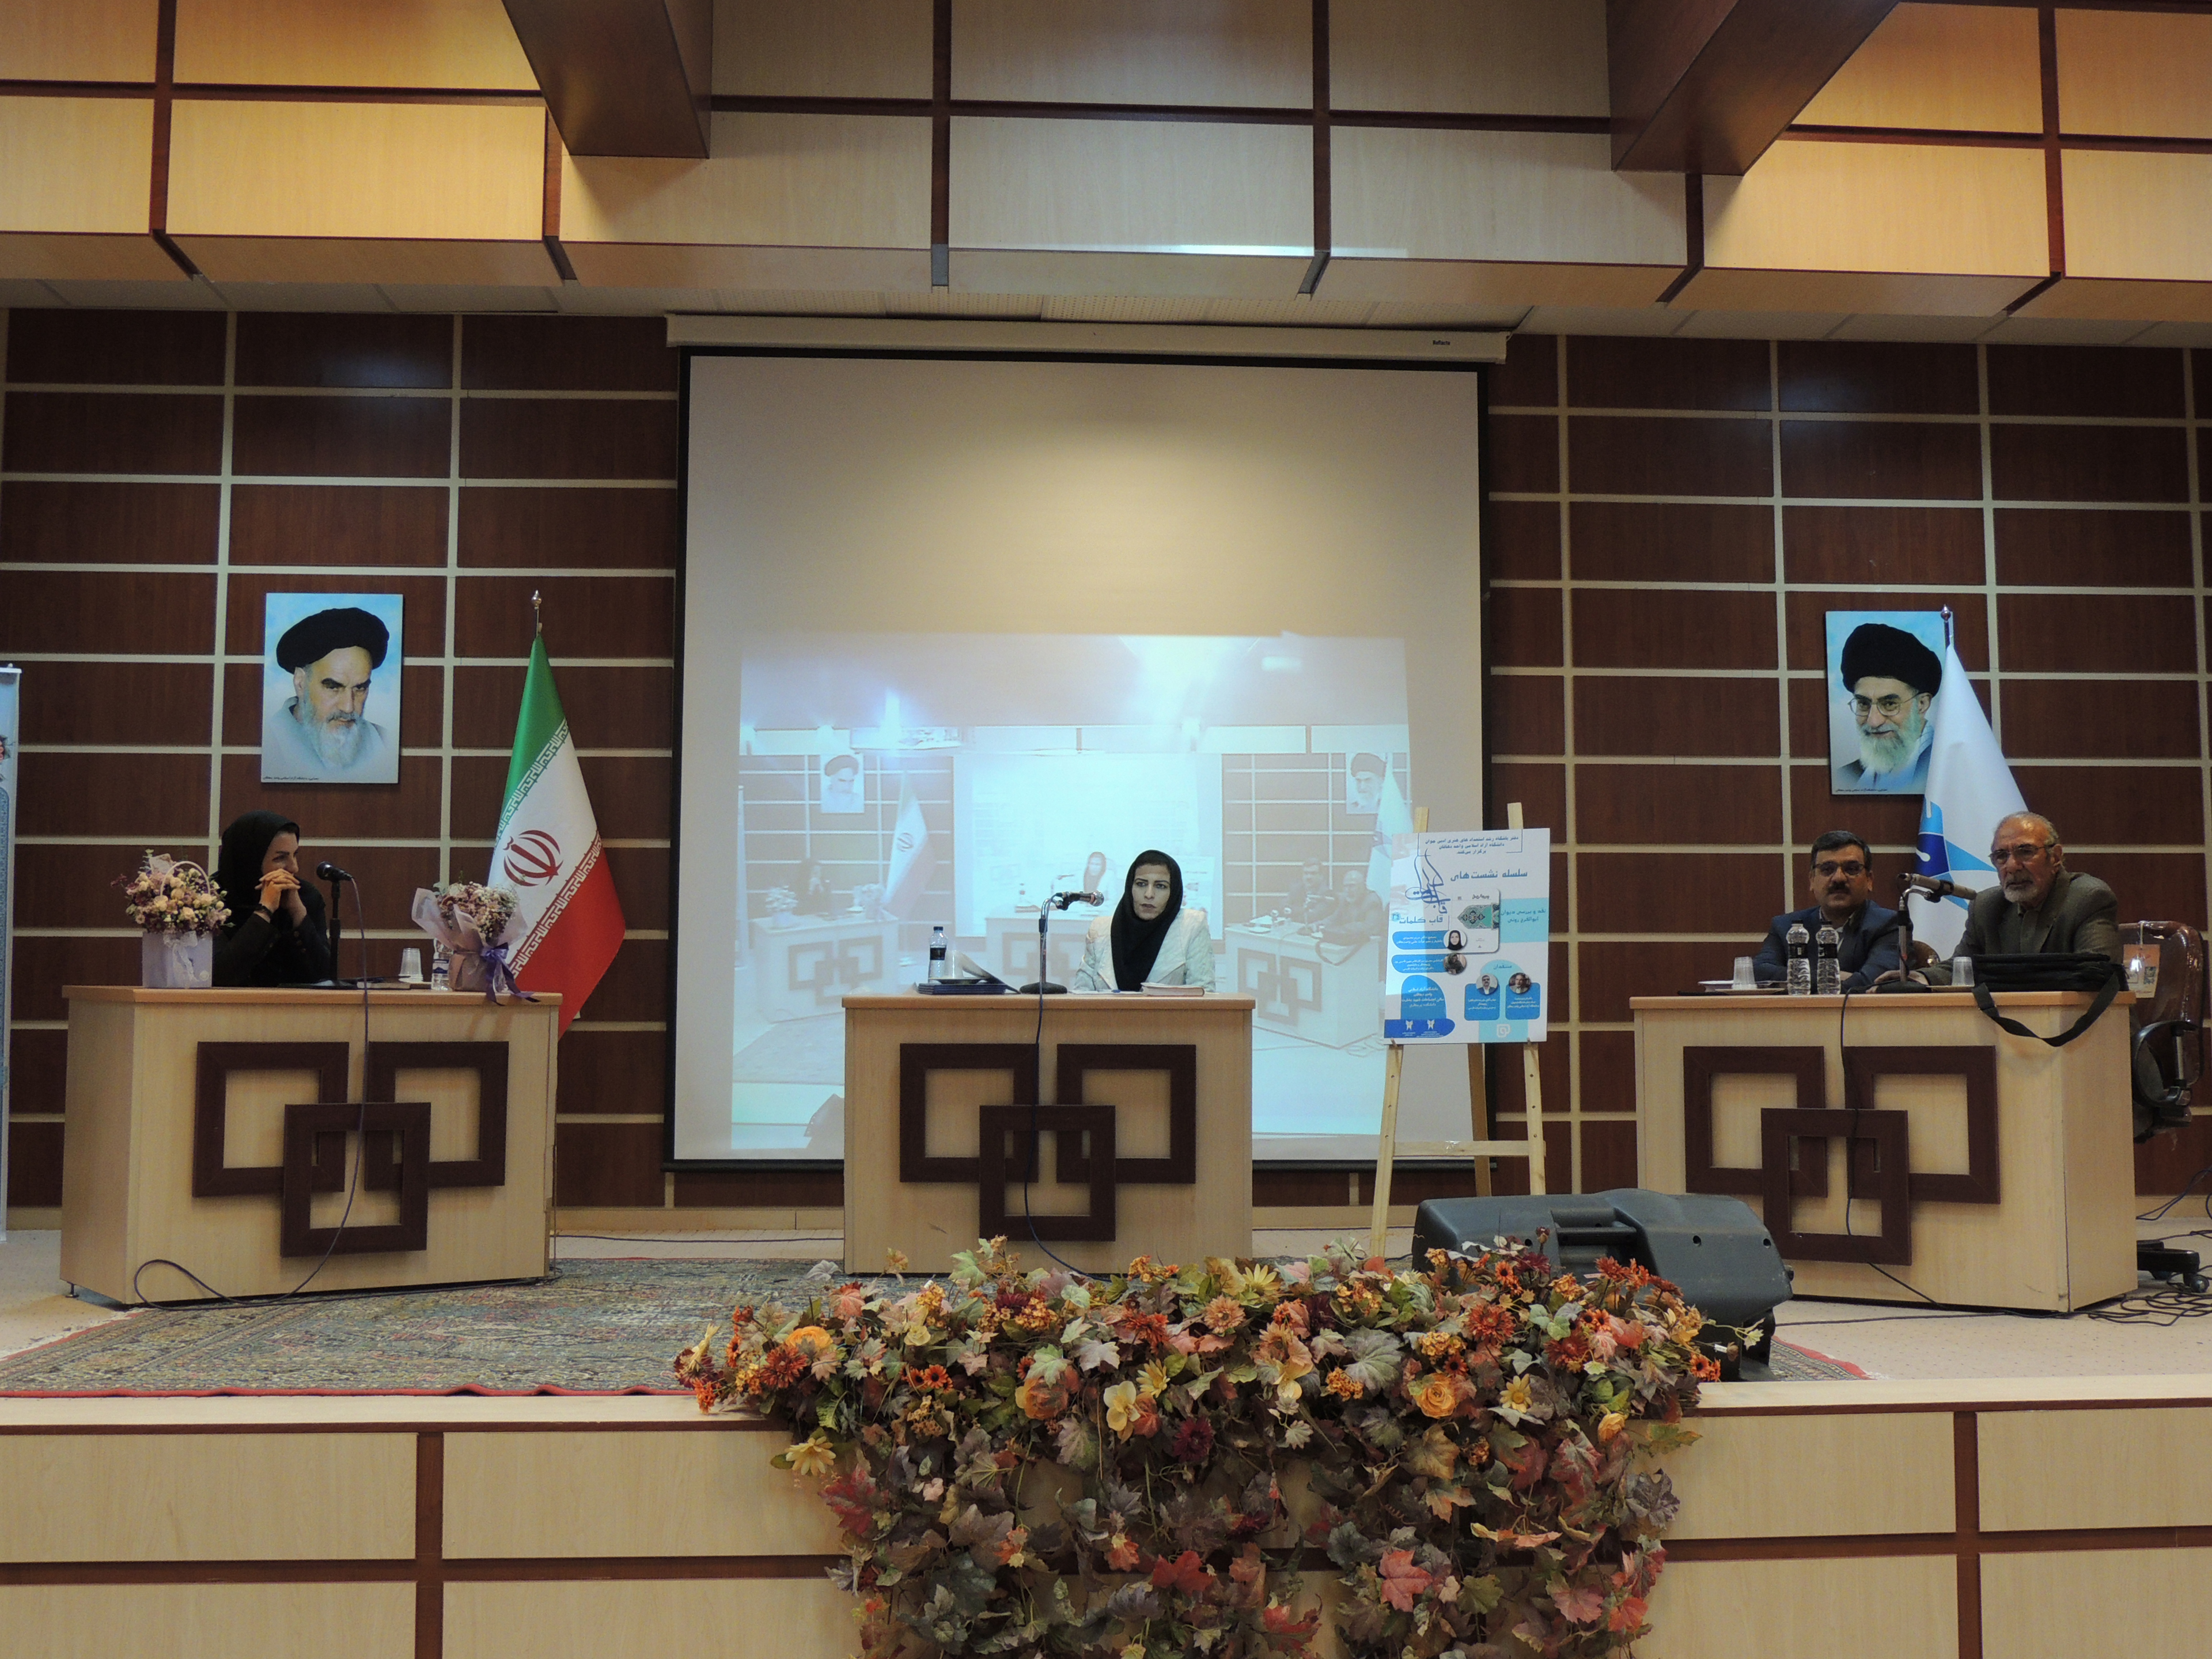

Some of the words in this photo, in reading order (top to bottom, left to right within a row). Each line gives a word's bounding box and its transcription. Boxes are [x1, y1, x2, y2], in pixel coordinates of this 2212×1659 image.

[1502, 868, 1528, 878] سلسله
[1399, 916, 1426, 924] کلمات
[1429, 914, 1443, 925] قاب
